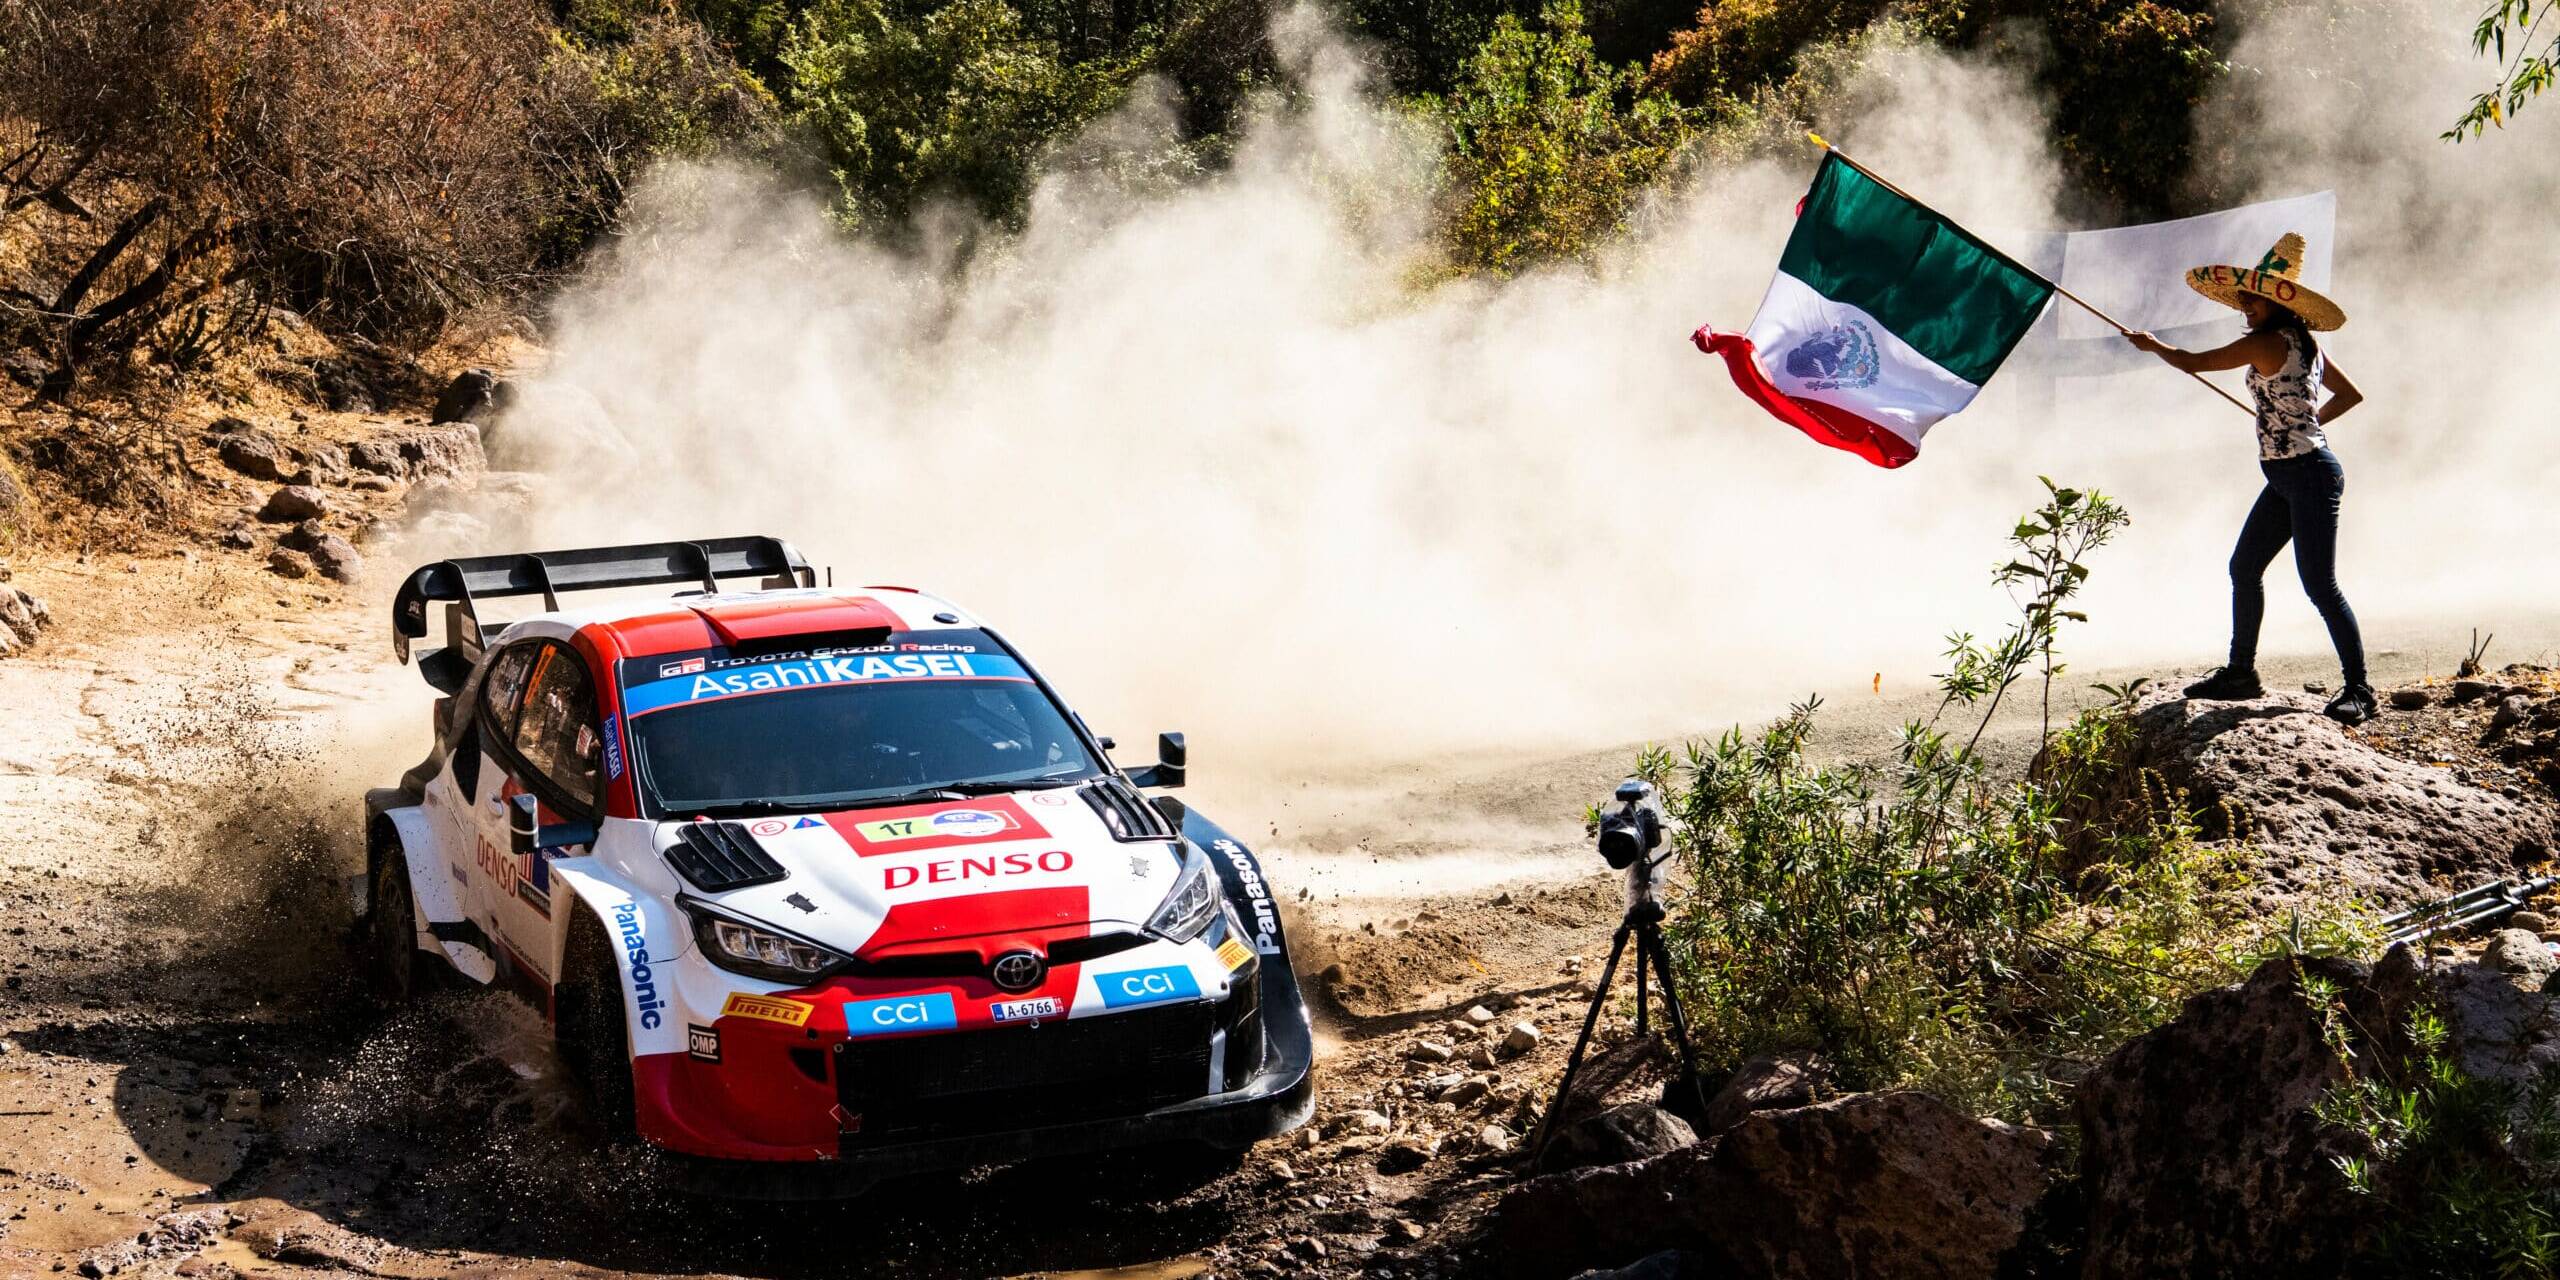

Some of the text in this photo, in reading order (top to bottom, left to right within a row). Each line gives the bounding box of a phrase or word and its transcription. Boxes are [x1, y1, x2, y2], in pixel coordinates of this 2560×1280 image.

[2193, 265, 2297, 302] MEXICO
[662, 663, 705, 677] GR
[711, 643, 976, 668] TOYOTA GAZOO Racing
[690, 654, 976, 700] AsahiKASEI
[880, 821, 913, 837] 17
[477, 832, 518, 898] DENSO
[884, 851, 1074, 890] DENSO
[1213, 839, 1281, 955] Panasonic
[610, 902, 666, 1031] Panasonic
[728, 996, 806, 1022] PIRELLI
[1008, 1001, 1052, 1018] A-6766
[690, 1034, 718, 1055] OMP
